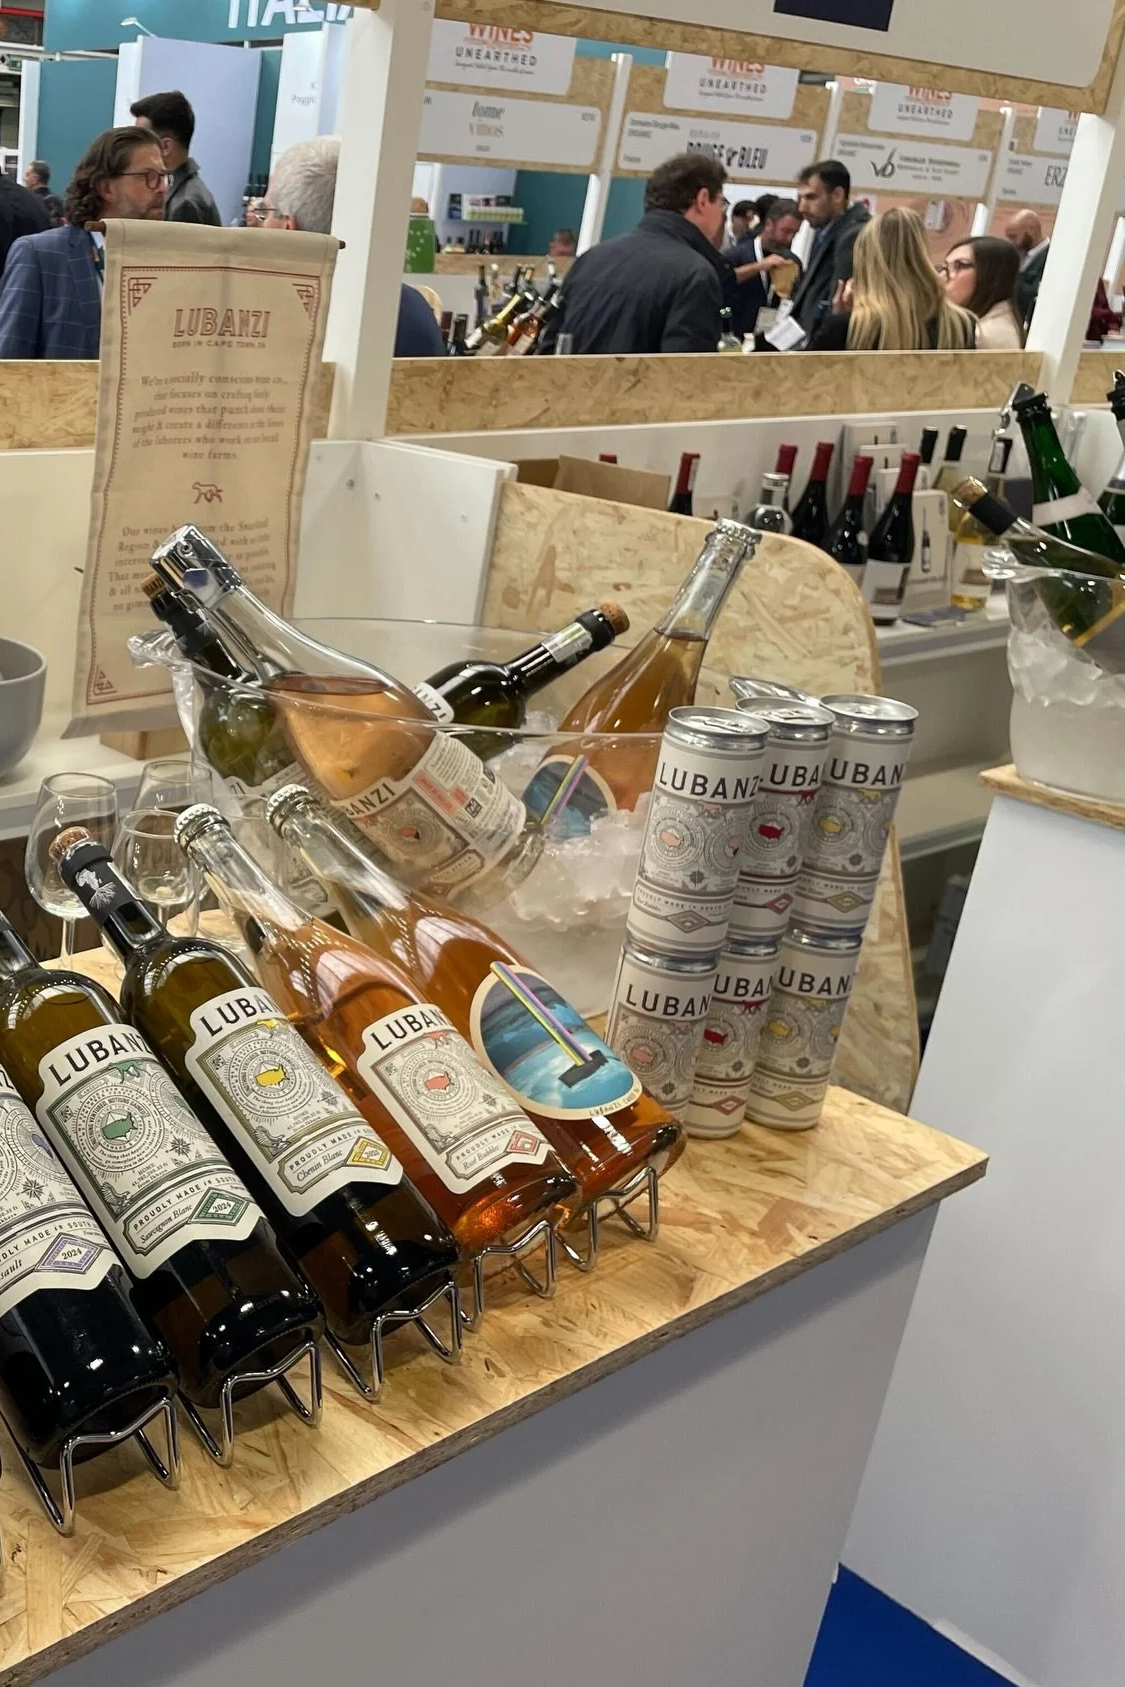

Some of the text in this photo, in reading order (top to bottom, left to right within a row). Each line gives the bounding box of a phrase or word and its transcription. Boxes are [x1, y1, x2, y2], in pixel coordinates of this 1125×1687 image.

[455, 46, 538, 66] UNEARTHED
[699, 77, 768, 94] UNEARTHED
[173, 307, 271, 339] LUBANZI
[206, 340, 232, 348] CAPE
[660, 760, 761, 802] LUBANZ
[830, 757, 905, 786] UBAN
[347, 783, 396, 818] BANZI
[713, 974, 774, 998] UBAN
[778, 966, 852, 997] UBAN
[625, 983, 713, 1018] LUBAN
[370, 1008, 448, 1050] LUBAN
[48, 1031, 154, 1088] LUBANZ
[289, 1141, 329, 1171] PROUDLY
[330, 1131, 353, 1144] MADE
[296, 1150, 344, 1182] Chenin Blanc
[132, 1198, 174, 1231] PROUDLY
[176, 1183, 202, 1199] MADE
[211, 1199, 232, 1214] 2024
[23, 1229, 52, 1246] MADE
[140, 1203, 193, 1244] Sauvignon Blanc
[60, 1247, 84, 1261] 2024
